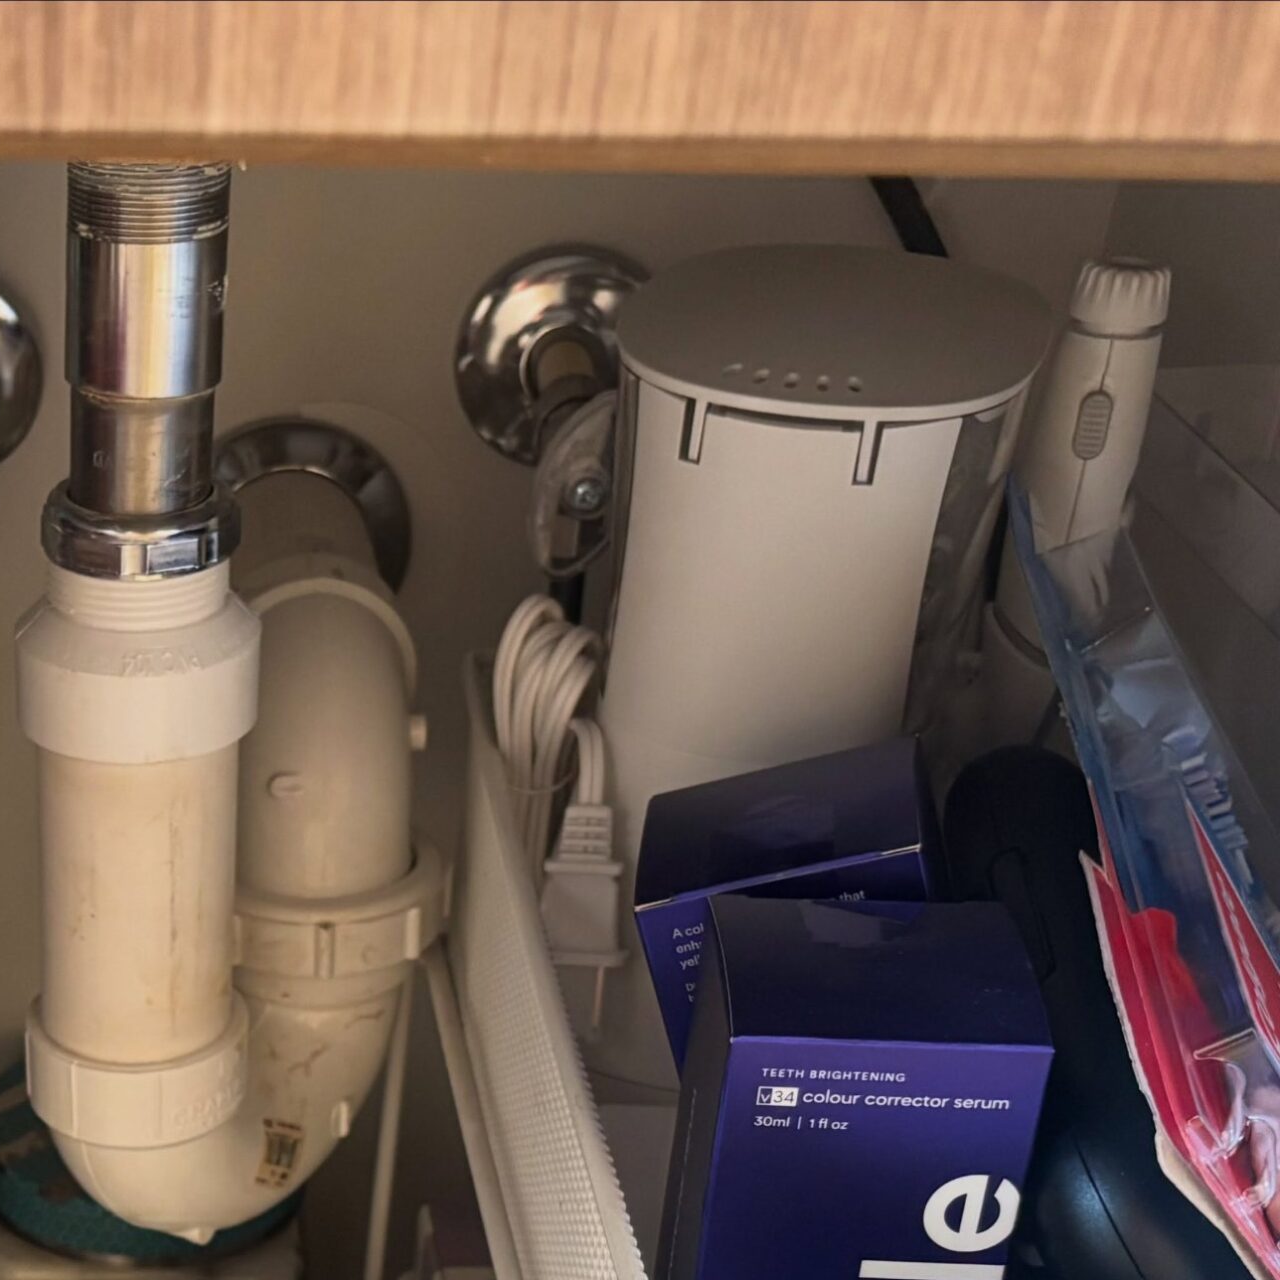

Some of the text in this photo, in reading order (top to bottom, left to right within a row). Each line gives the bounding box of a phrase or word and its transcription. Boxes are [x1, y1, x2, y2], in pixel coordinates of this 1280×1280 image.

[762, 1067, 906, 1083] TEETH BRIGHTENING
[802, 1088, 860, 1105] colour
[864, 1093, 950, 1108] corrector
[953, 1097, 1010, 1110] serum
[753, 1115, 791, 1128] 30ml
[809, 1118, 815, 1129] 1
[818, 1117, 828, 1129] fl
[831, 1120, 849, 1131] oz
